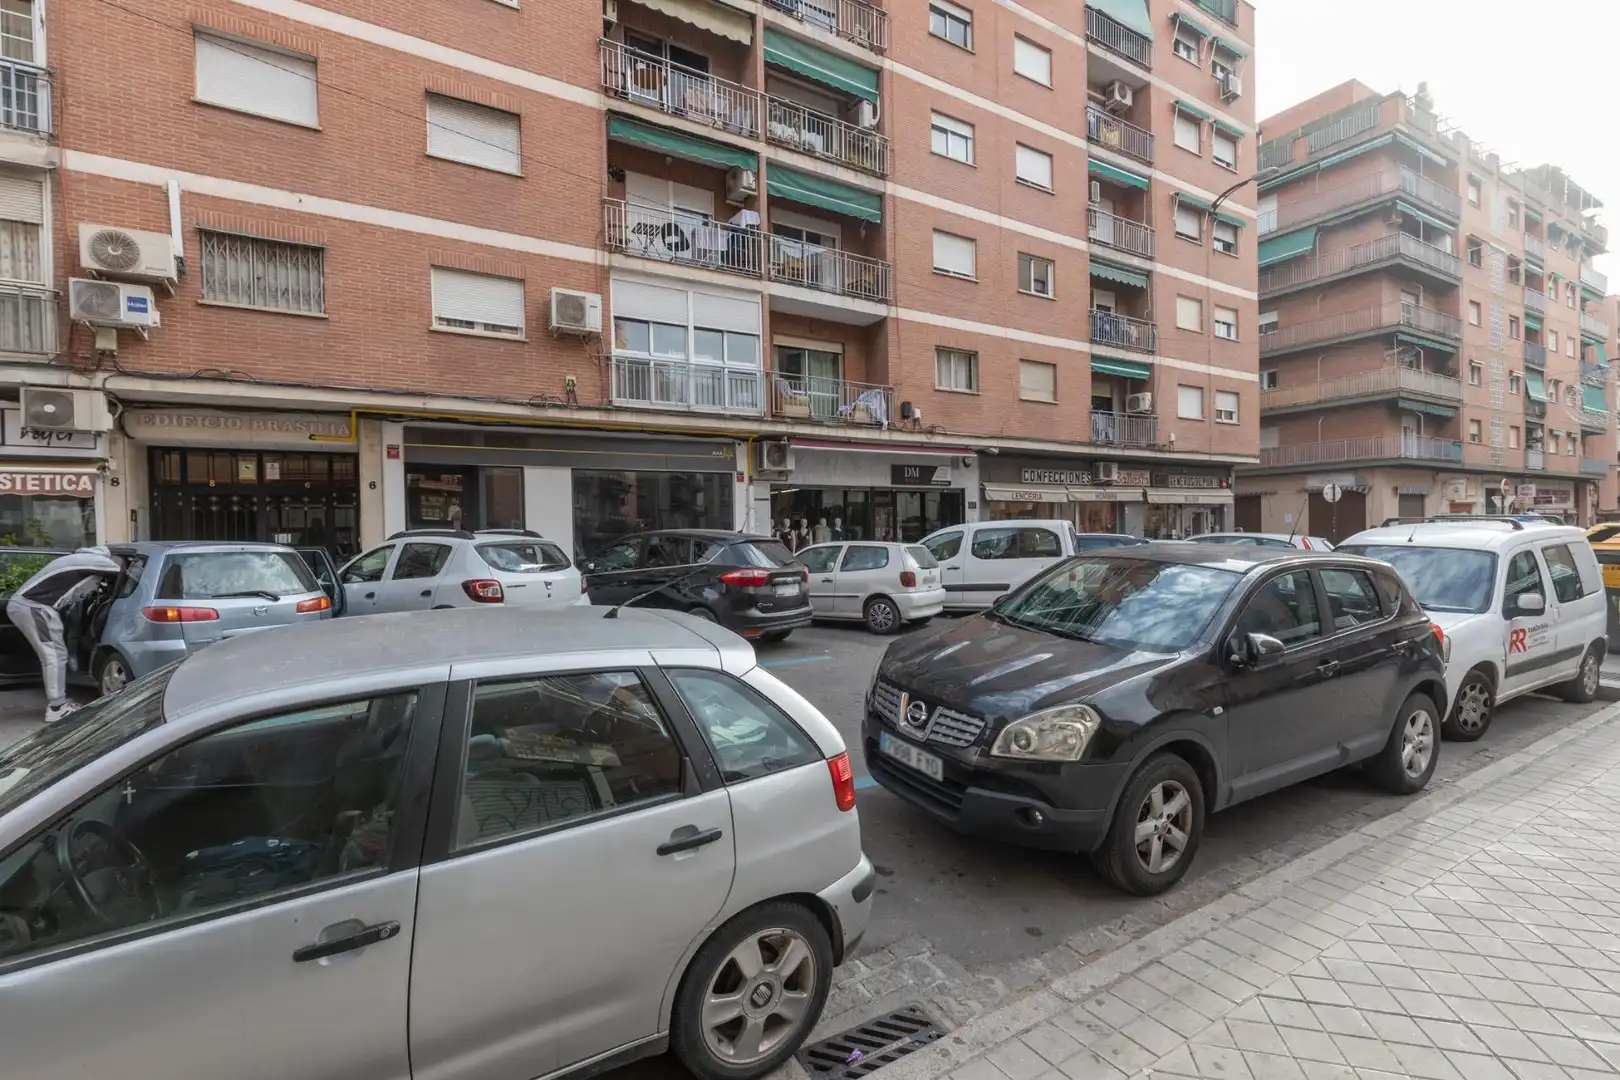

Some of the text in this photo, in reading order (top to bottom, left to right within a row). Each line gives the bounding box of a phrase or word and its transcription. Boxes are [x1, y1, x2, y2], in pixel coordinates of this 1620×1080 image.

[138, 413, 350, 436] EDIFICIO BRASILIA
[904, 466, 920, 478] DM
[1023, 470, 1091, 484] CONFECCIONES
[0, 473, 93, 491] STETICA
[110, 476, 120, 487] 8
[209, 479, 216, 487] 8
[368, 480, 377, 490] 6
[1509, 628, 1527, 655] RR
